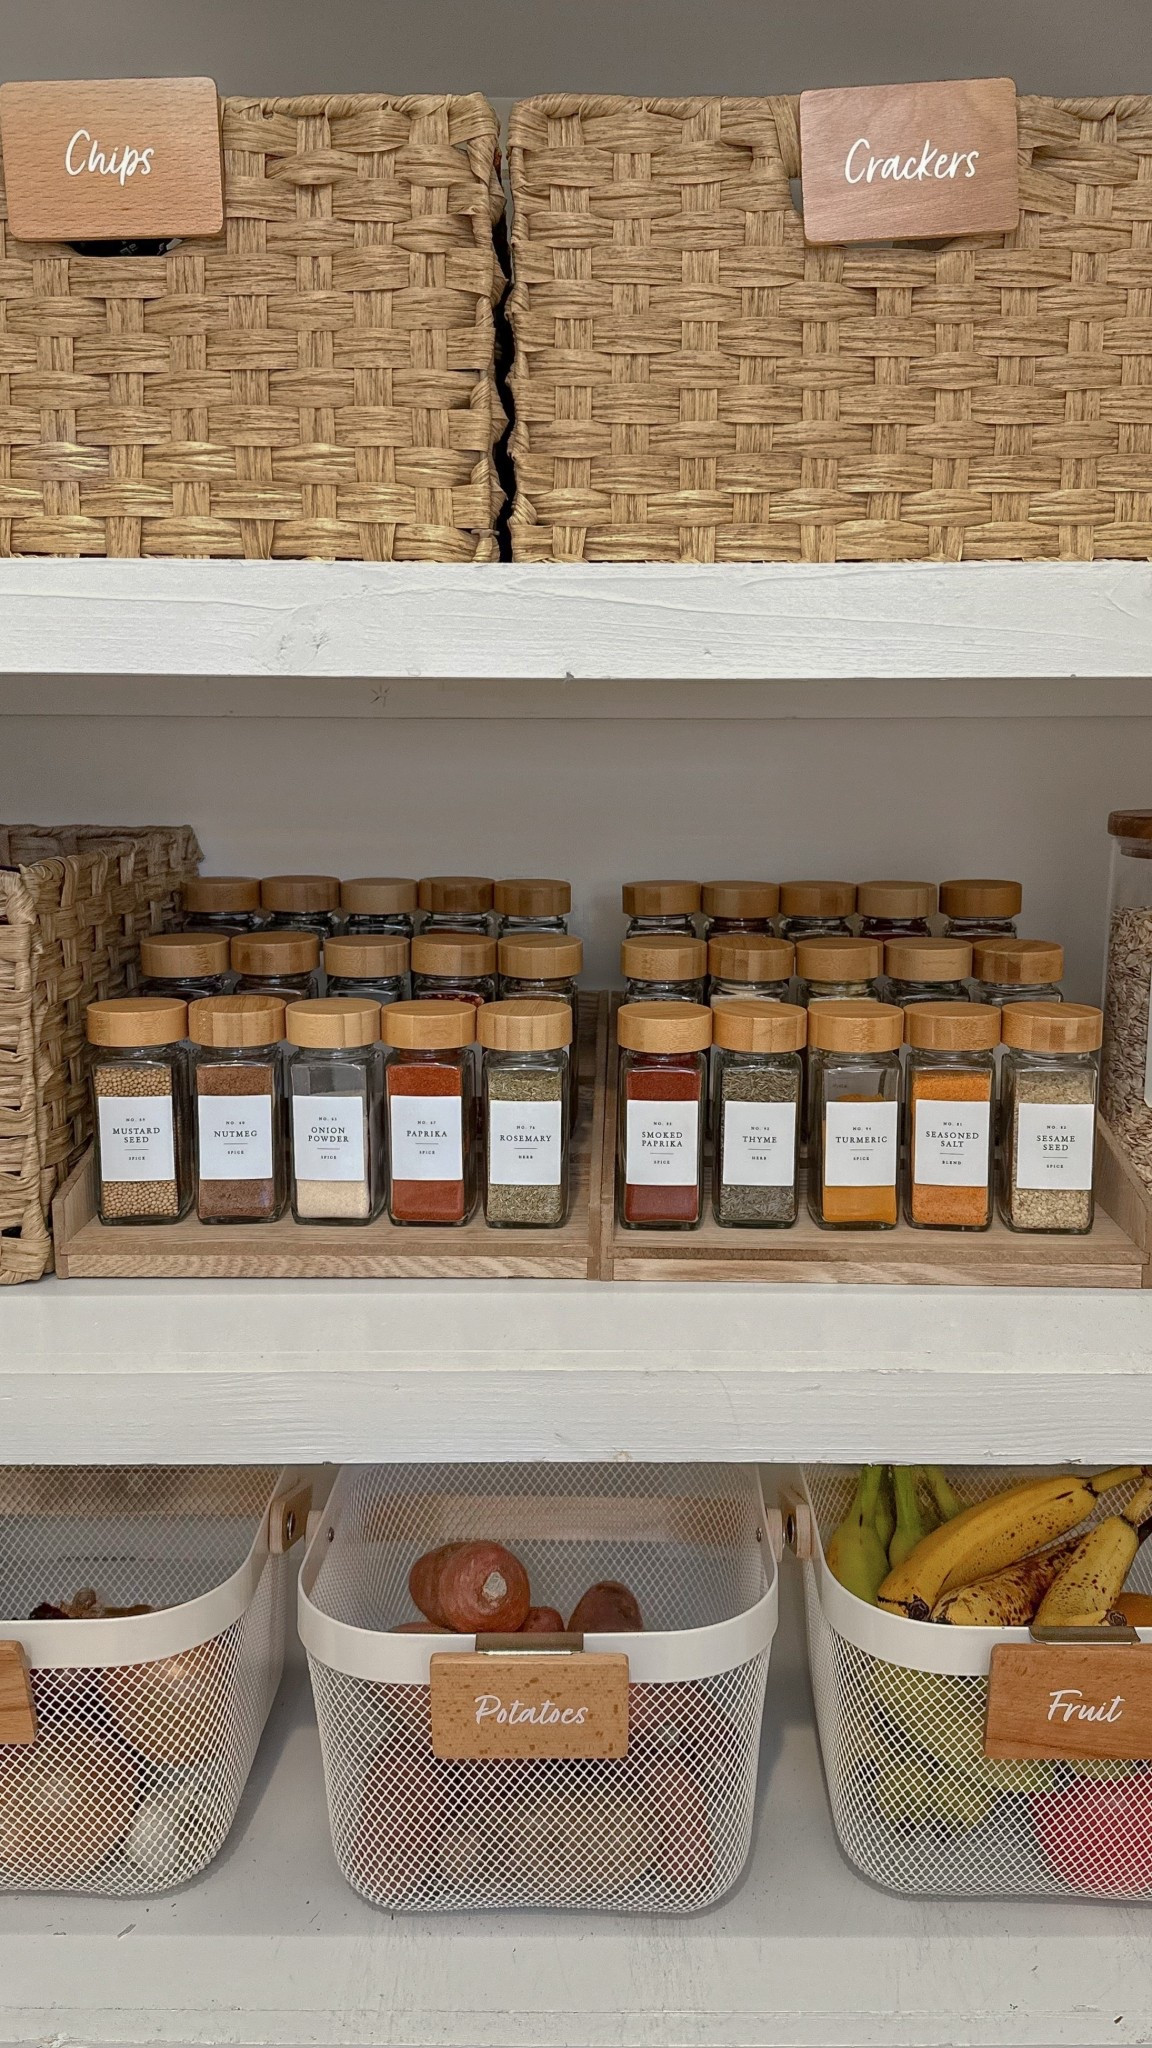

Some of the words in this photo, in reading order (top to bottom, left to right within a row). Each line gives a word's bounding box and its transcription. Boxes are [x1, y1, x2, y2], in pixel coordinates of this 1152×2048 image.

[64, 128, 155, 187] Chips
[844, 137, 980, 184] Crackers
[112, 1127, 161, 1136] MUSTARD
[213, 1129, 258, 1138] NUTMEG
[310, 1126, 346, 1135] ONION
[406, 1129, 448, 1138] PAPRIKA
[925, 1130, 980, 1140] SEASONED
[123, 1136, 150, 1144] SEED
[307, 1134, 350, 1143] POWDER
[499, 1134, 552, 1143] ROSEMARY
[641, 1131, 684, 1140] SMOKED
[741, 1135, 778, 1144] THYME
[834, 1135, 888, 1144] TURMERIC
[1036, 1134, 1076, 1144] SESAME
[641, 1139, 684, 1148] PAPRIKA
[940, 1139, 965, 1148] SALT
[1042, 1143, 1069, 1152] SEED
[474, 1694, 589, 1725] Potatoes
[1047, 1688, 1126, 1723] Fruit
